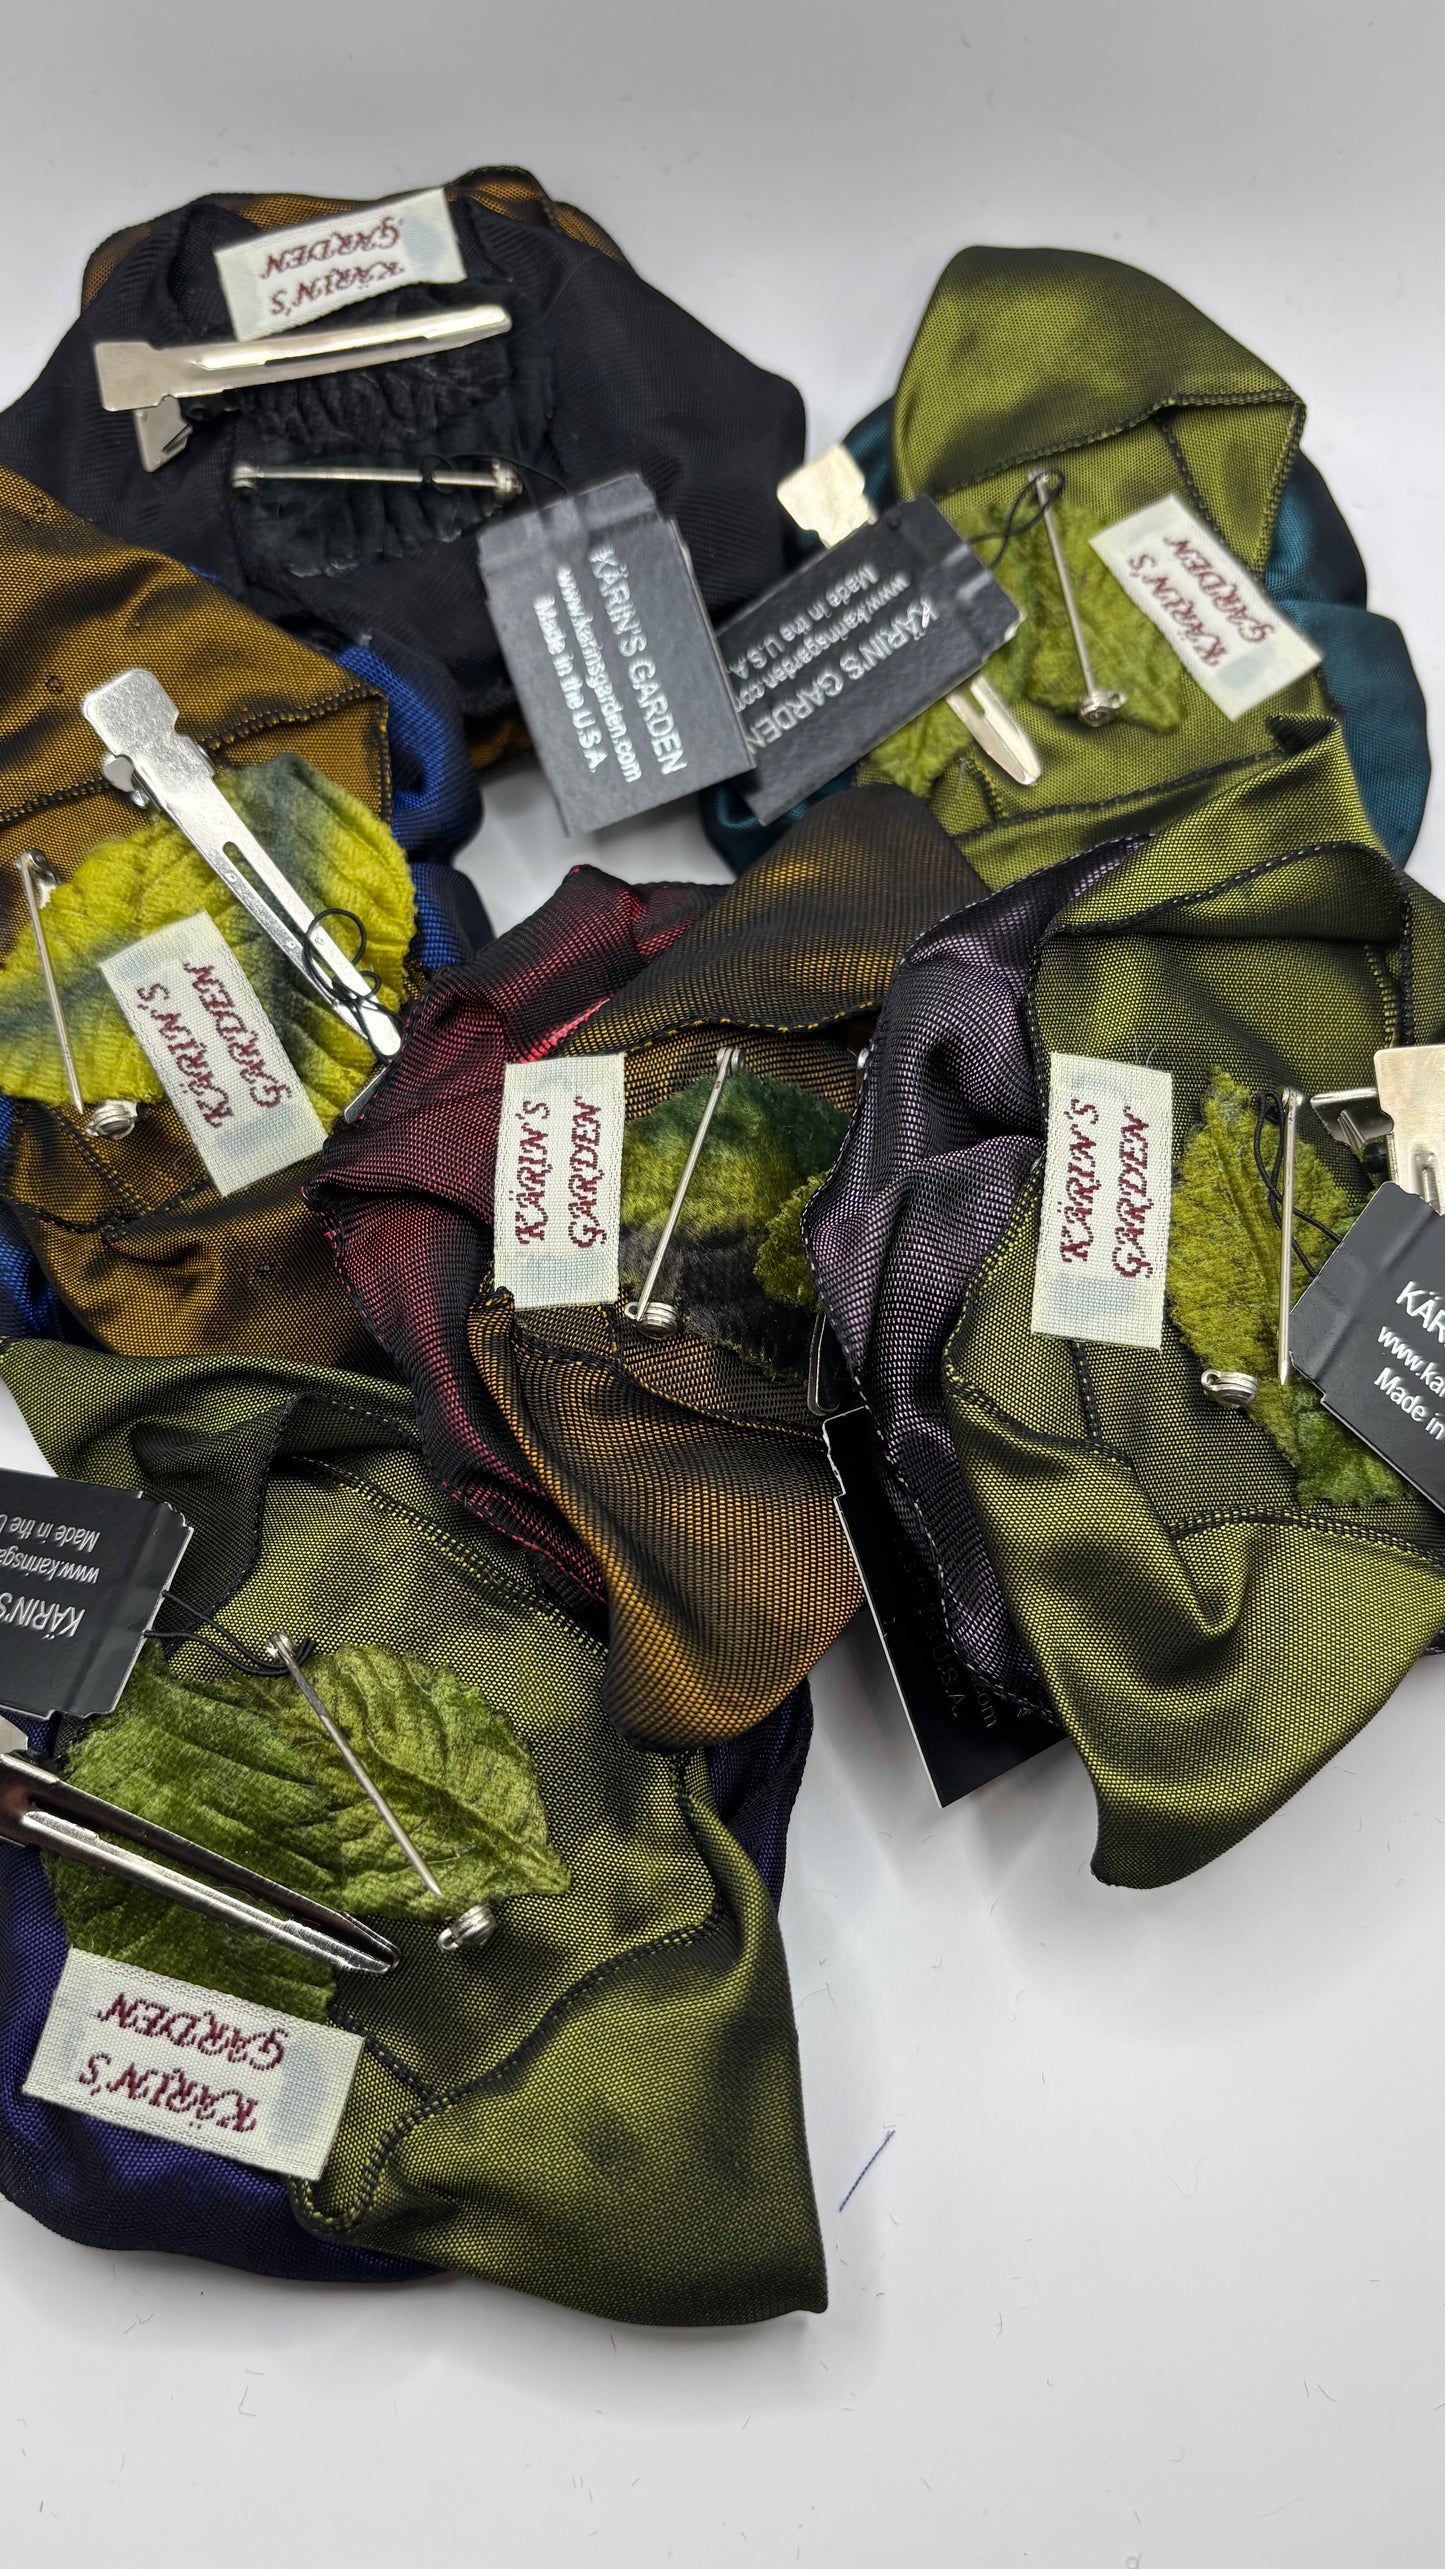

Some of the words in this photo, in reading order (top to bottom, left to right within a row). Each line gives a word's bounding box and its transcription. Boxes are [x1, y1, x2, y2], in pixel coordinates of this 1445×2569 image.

[262, 217, 401, 278] GARDEN
[270, 261, 403, 316] KÄRIN'S
[808, 602, 830, 620] in
[826, 566, 877, 607] Made
[1130, 554, 1226, 665] KÄRIN'S
[1165, 539, 1273, 642] GARDEN
[534, 597, 565, 654] Made
[590, 546, 647, 656] KÄRIN'S
[629, 659, 687, 774] GARDEN
[730, 635, 784, 679] U.S.A.
[780, 616, 811, 641] the
[840, 599, 938, 679] KÄRIN'S
[553, 655, 573, 677] in
[558, 568, 641, 782] www.karinsgarden.com
[561, 675, 584, 709] the
[573, 710, 607, 773] U.S.A.
[136, 984, 234, 1128] KÄRIN'S
[183, 963, 292, 1108] GARDEN
[509, 1101, 553, 1245] KÄRIN'S
[568, 1096, 607, 1248] GARDEN
[1057, 1099, 1101, 1262] KÄRIN'S
[1112, 1106, 1154, 1278] GARDEN
[1374, 1367, 1426, 1421] Made
[1426, 1413, 1445, 1439] in
[10, 1517, 35, 1539] the
[37, 1522, 53, 1543] in
[55, 1525, 100, 1552] Made
[97, 1993, 288, 2071] GARDEN
[79, 2053, 258, 2132] KÄRIN'S
